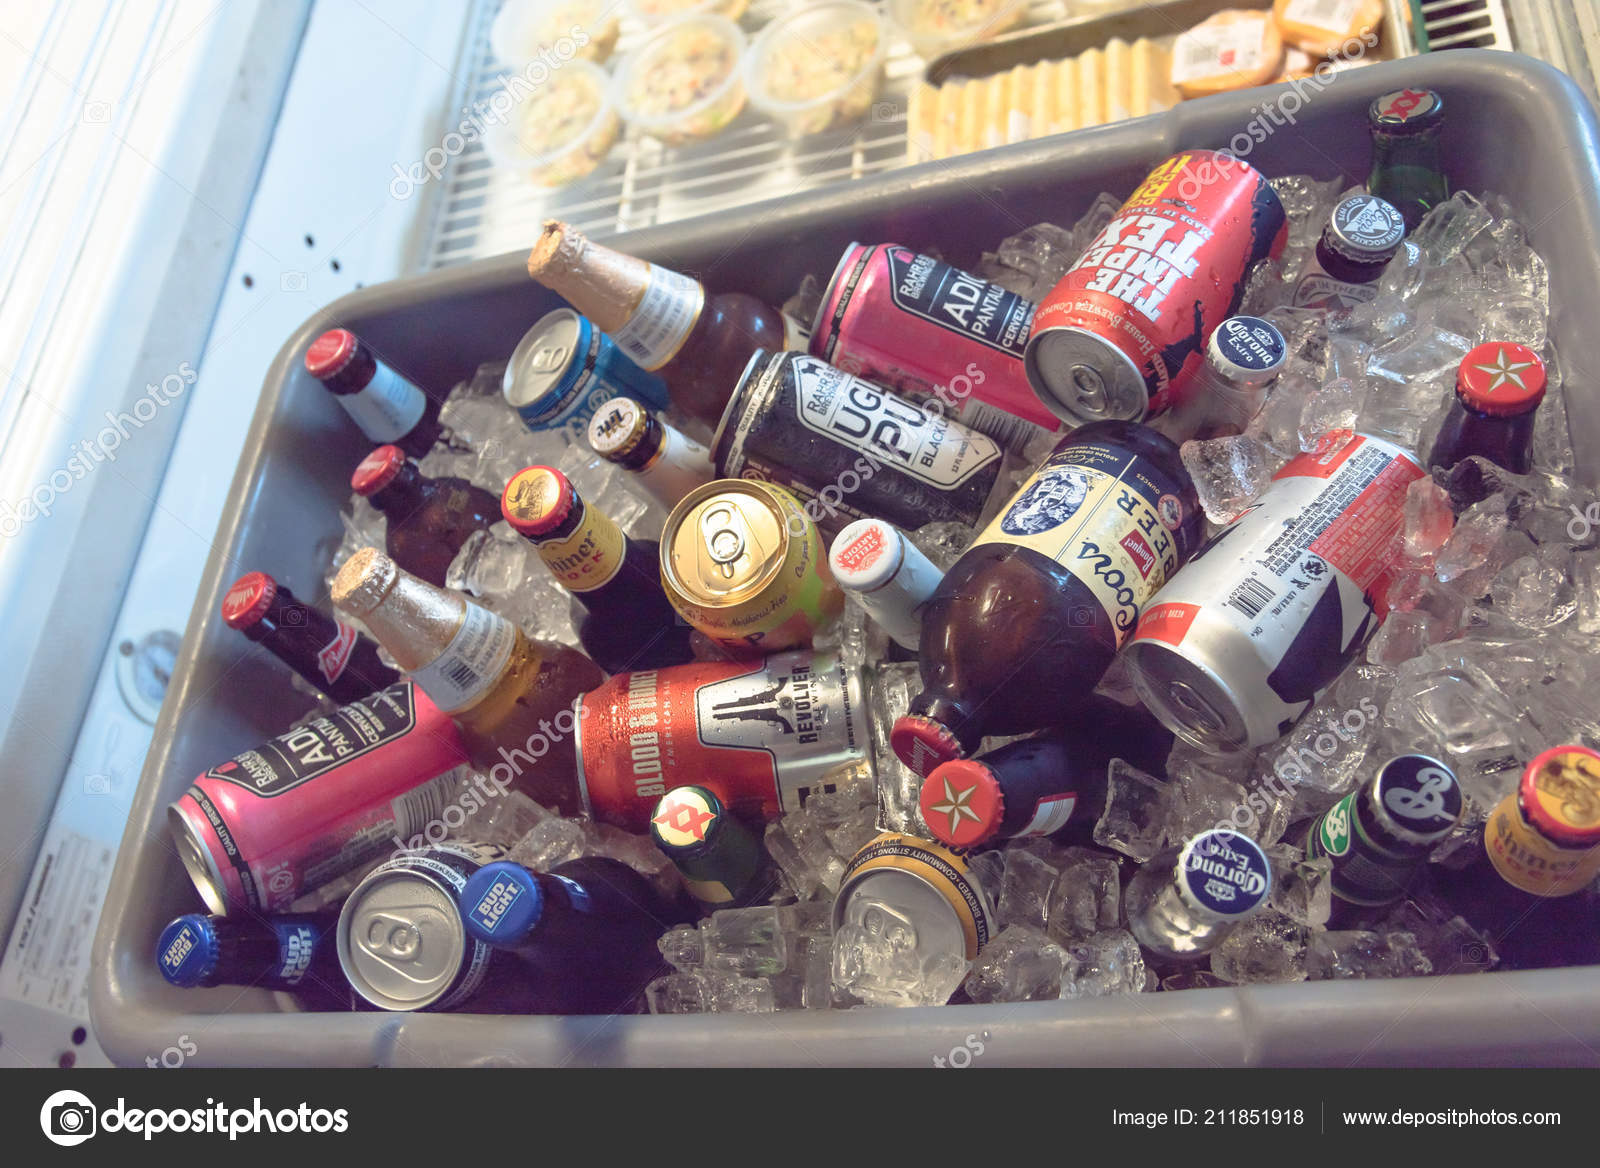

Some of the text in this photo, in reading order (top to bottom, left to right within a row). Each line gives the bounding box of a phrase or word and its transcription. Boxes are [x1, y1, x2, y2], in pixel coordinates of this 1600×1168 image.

[1091, 214, 1207, 278] TEX
[898, 262, 924, 298] RAHR
[1085, 267, 1163, 323] THE
[1123, 326, 1154, 355] HOUSE
[1225, 320, 1274, 367] Corona
[1227, 337, 1254, 362] Extra
[806, 377, 834, 414] RAHR
[920, 423, 946, 468] BLACK
[1136, 473, 1161, 495] OUNCES
[840, 532, 876, 561] ARTOIS
[845, 538, 880, 566] STELLA
[1115, 489, 1176, 580] BEER
[1124, 537, 1155, 573] Banquet
[1076, 541, 1139, 632] Coors
[792, 665, 818, 744] REVOLVER
[810, 672, 823, 732] BREWING
[662, 700, 675, 765] AMERICAN
[630, 732, 665, 797] BLOOD
[215, 823, 237, 857] QUALITY
[877, 847, 910, 855] STRONG
[1209, 842, 1250, 869] Extra
[908, 849, 957, 880] COMMUNITY
[1188, 854, 1266, 896] Corona
[478, 882, 505, 914] BUD
[483, 883, 519, 928] LIGHT
[958, 880, 981, 918] BREWED
[164, 927, 191, 965] LIGHT
[171, 944, 194, 969] BUD
[280, 935, 301, 978] BUD
